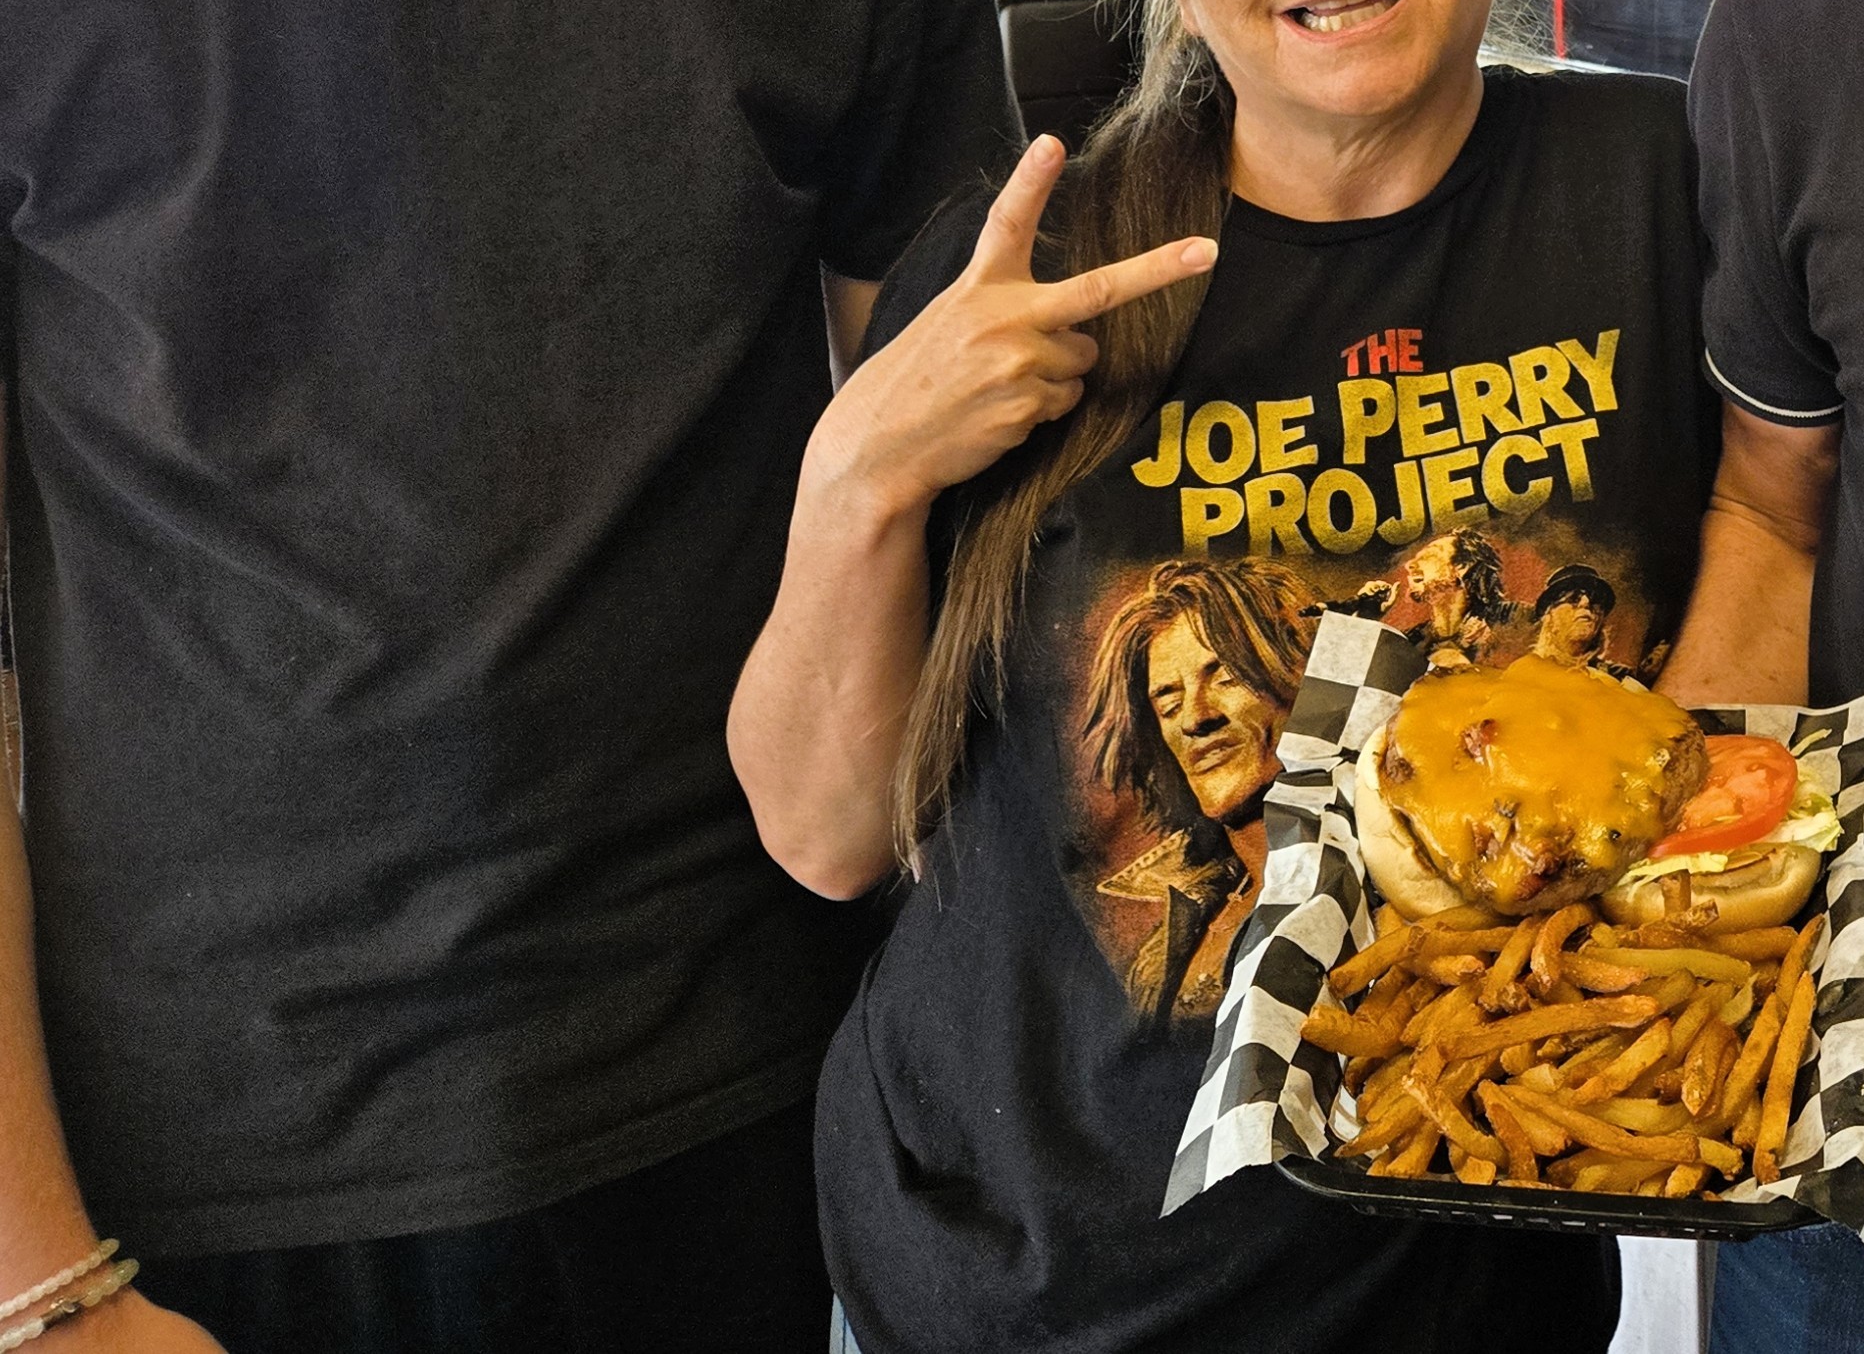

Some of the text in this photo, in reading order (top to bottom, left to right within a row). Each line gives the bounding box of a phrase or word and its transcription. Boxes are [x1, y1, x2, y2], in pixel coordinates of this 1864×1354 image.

[1130, 329, 1620, 488] JOE PERRY
[1340, 328, 1424, 377] THE
[1181, 418, 1599, 557] PROJECT
